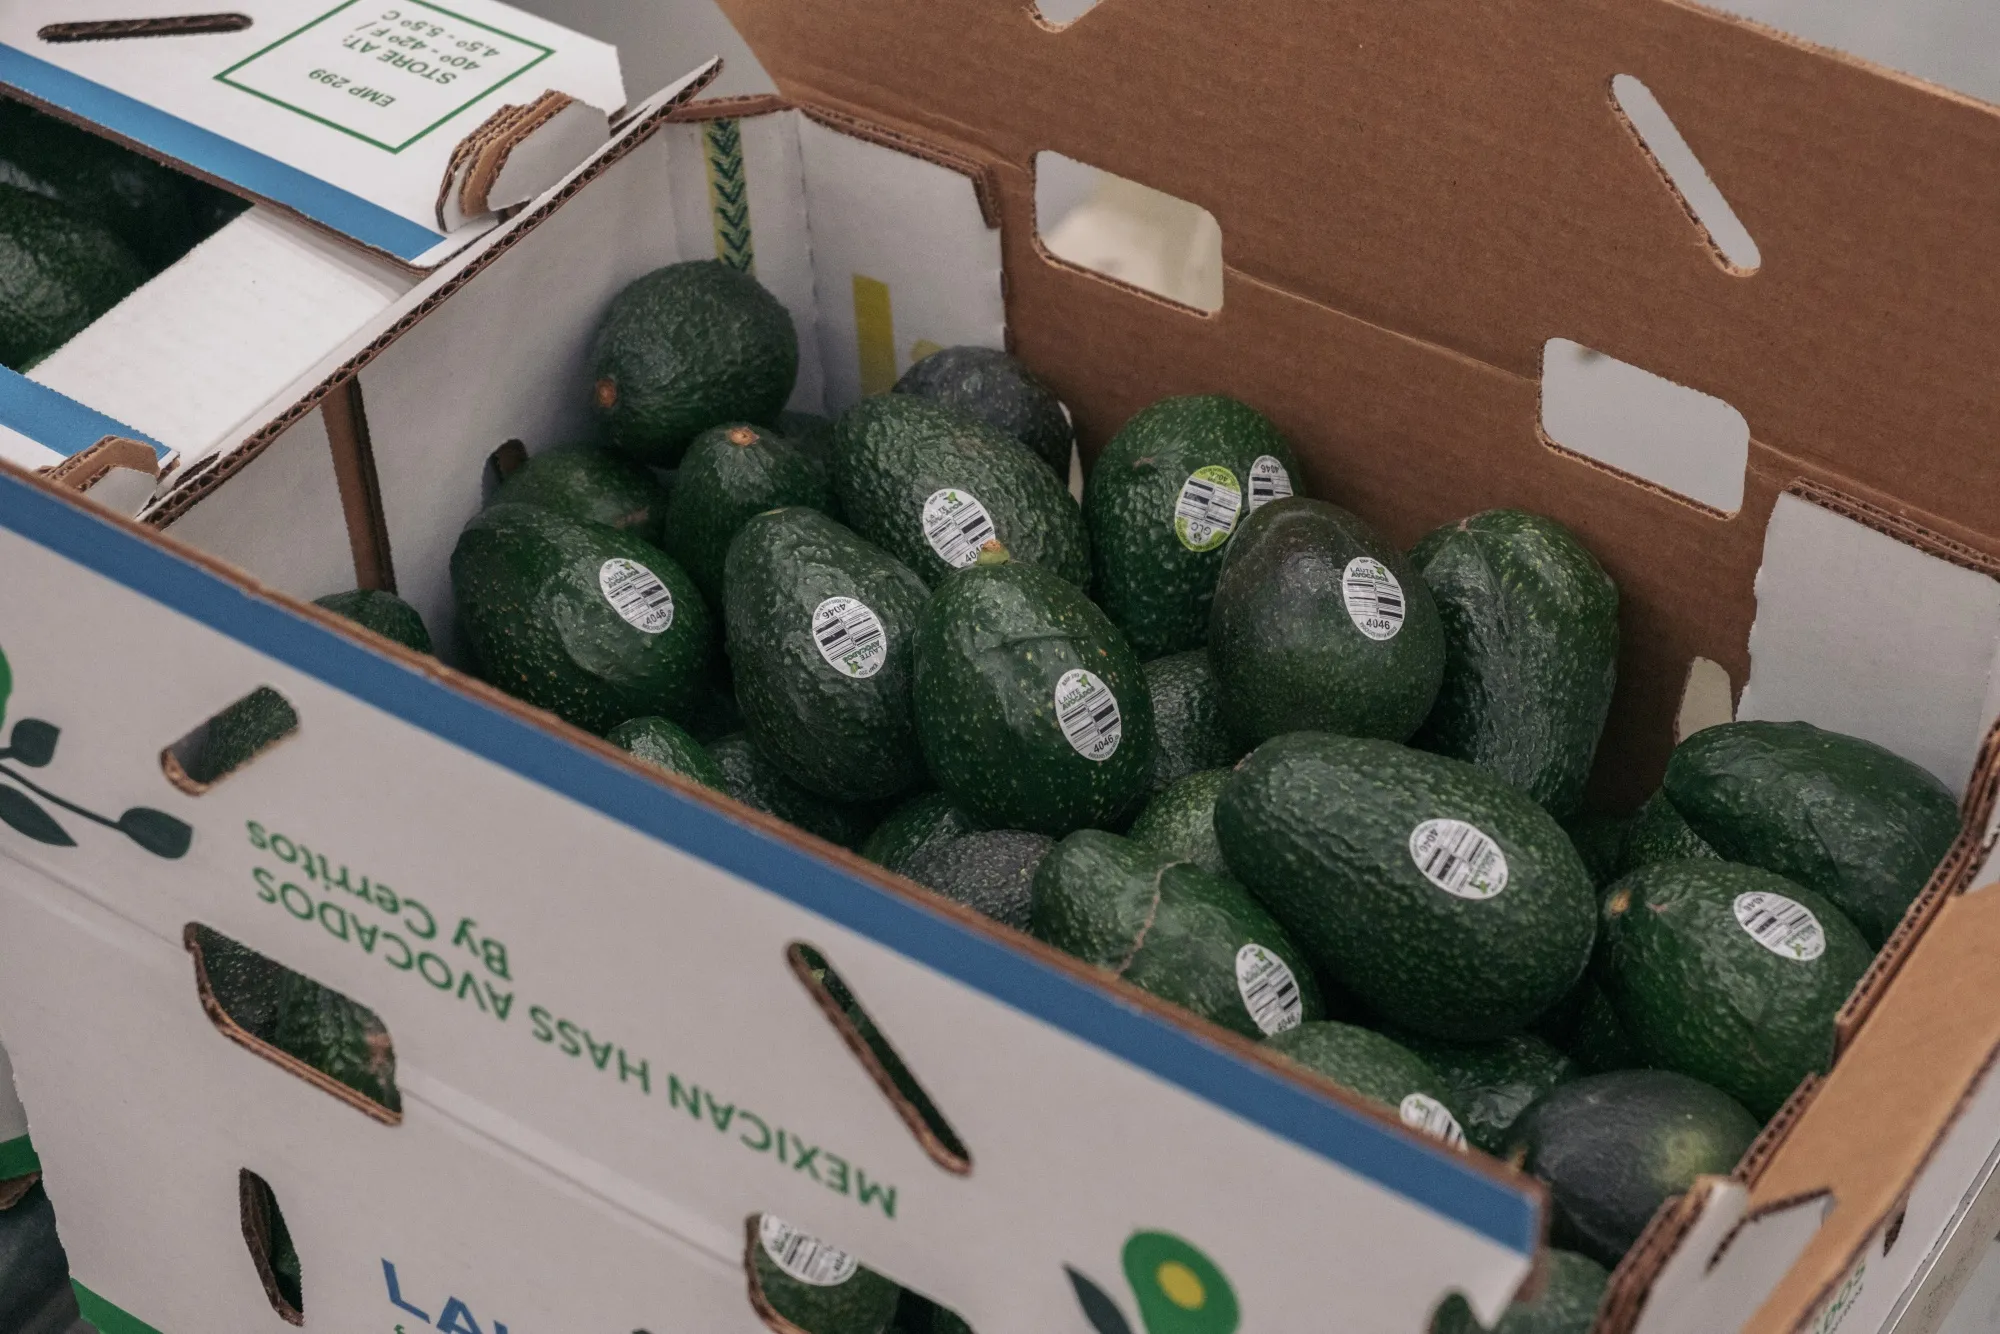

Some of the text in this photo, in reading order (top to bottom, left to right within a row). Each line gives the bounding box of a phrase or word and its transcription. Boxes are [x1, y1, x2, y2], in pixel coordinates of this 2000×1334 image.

[381, 9, 400, 21] C
[369, 25, 391, 37] F
[343, 34, 457, 85] STORE AT:
[308, 68, 396, 108] EMP 299
[1261, 464, 1280, 474] 4046
[1191, 521, 1211, 535] GLC
[603, 571, 625, 583] LAUTE
[646, 609, 667, 625] 4046
[822, 603, 846, 619] 4046
[1366, 618, 1390, 630] 4046
[861, 646, 883, 661] LAUTE
[1058, 688, 1081, 705] LAUTE
[1062, 686, 1095, 710] AVOCADOS
[1093, 734, 1114, 753] 4046
[246, 820, 512, 982] By Cerritos
[253, 867, 897, 1219] MEXICAN HASS AVOCADOS
